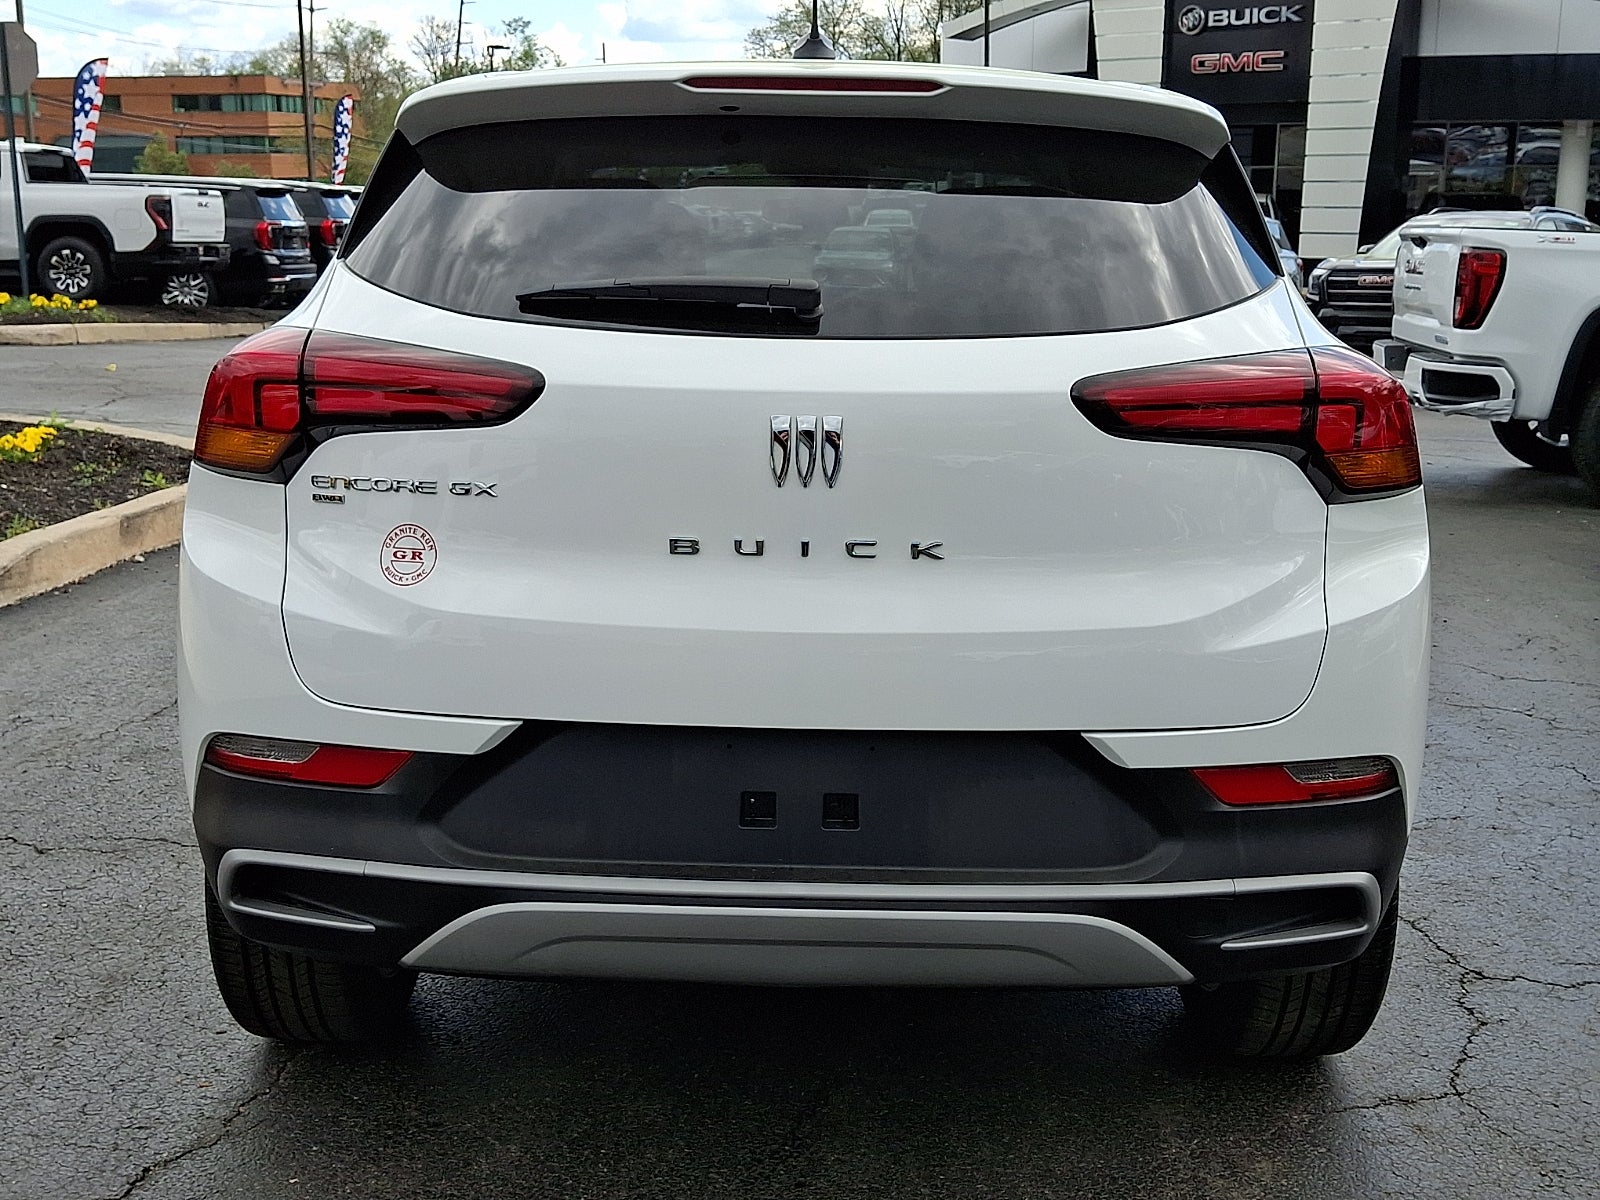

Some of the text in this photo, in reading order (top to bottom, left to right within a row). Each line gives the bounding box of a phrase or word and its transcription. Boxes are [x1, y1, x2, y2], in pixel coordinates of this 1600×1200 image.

[1207, 4, 1304, 27] BUICK
[1191, 50, 1284, 74] GMC
[311, 474, 498, 497] ENCORE GX
[385, 527, 435, 551] GRANITE RUN
[669, 536, 945, 559] BUICK
[385, 566, 428, 582] BUICK GMC
